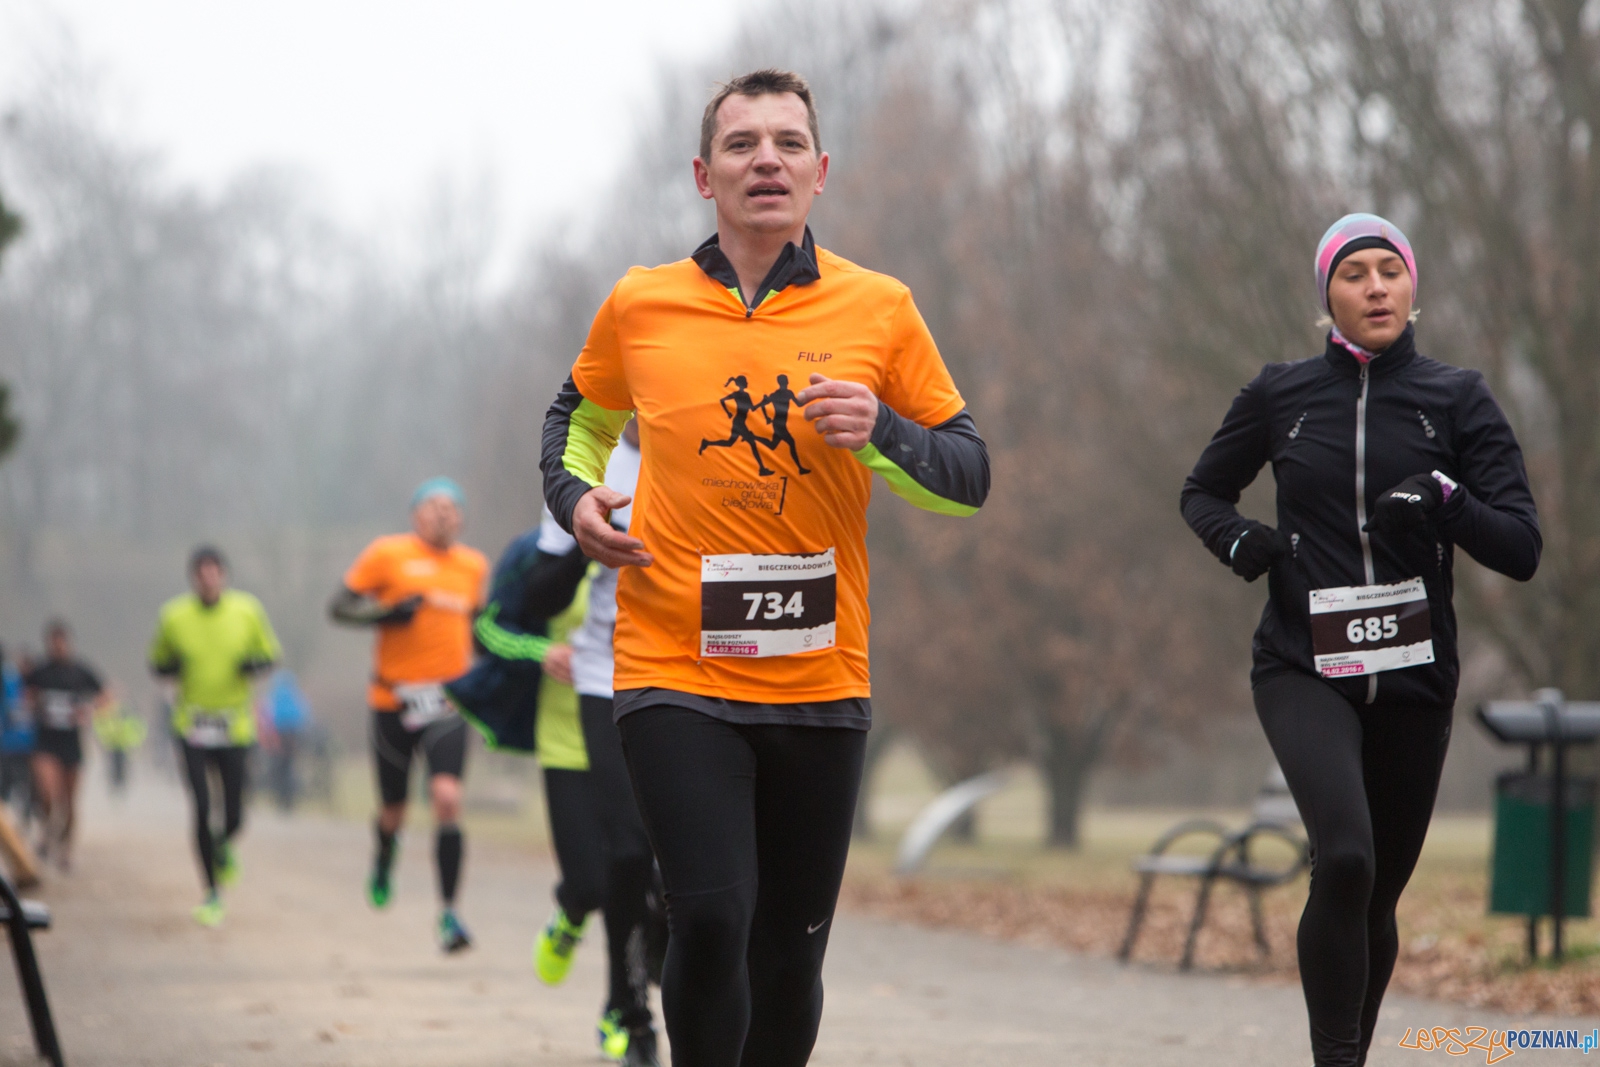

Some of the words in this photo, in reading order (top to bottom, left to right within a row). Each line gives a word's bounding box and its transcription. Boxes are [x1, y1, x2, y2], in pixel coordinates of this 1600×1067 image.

[797, 351, 833, 363] FILIP
[702, 476, 780, 491] miechowicka
[740, 489, 776, 501] grupa
[721, 496, 774, 510] biegowa
[742, 591, 805, 620] 734
[1346, 614, 1399, 643] 685
